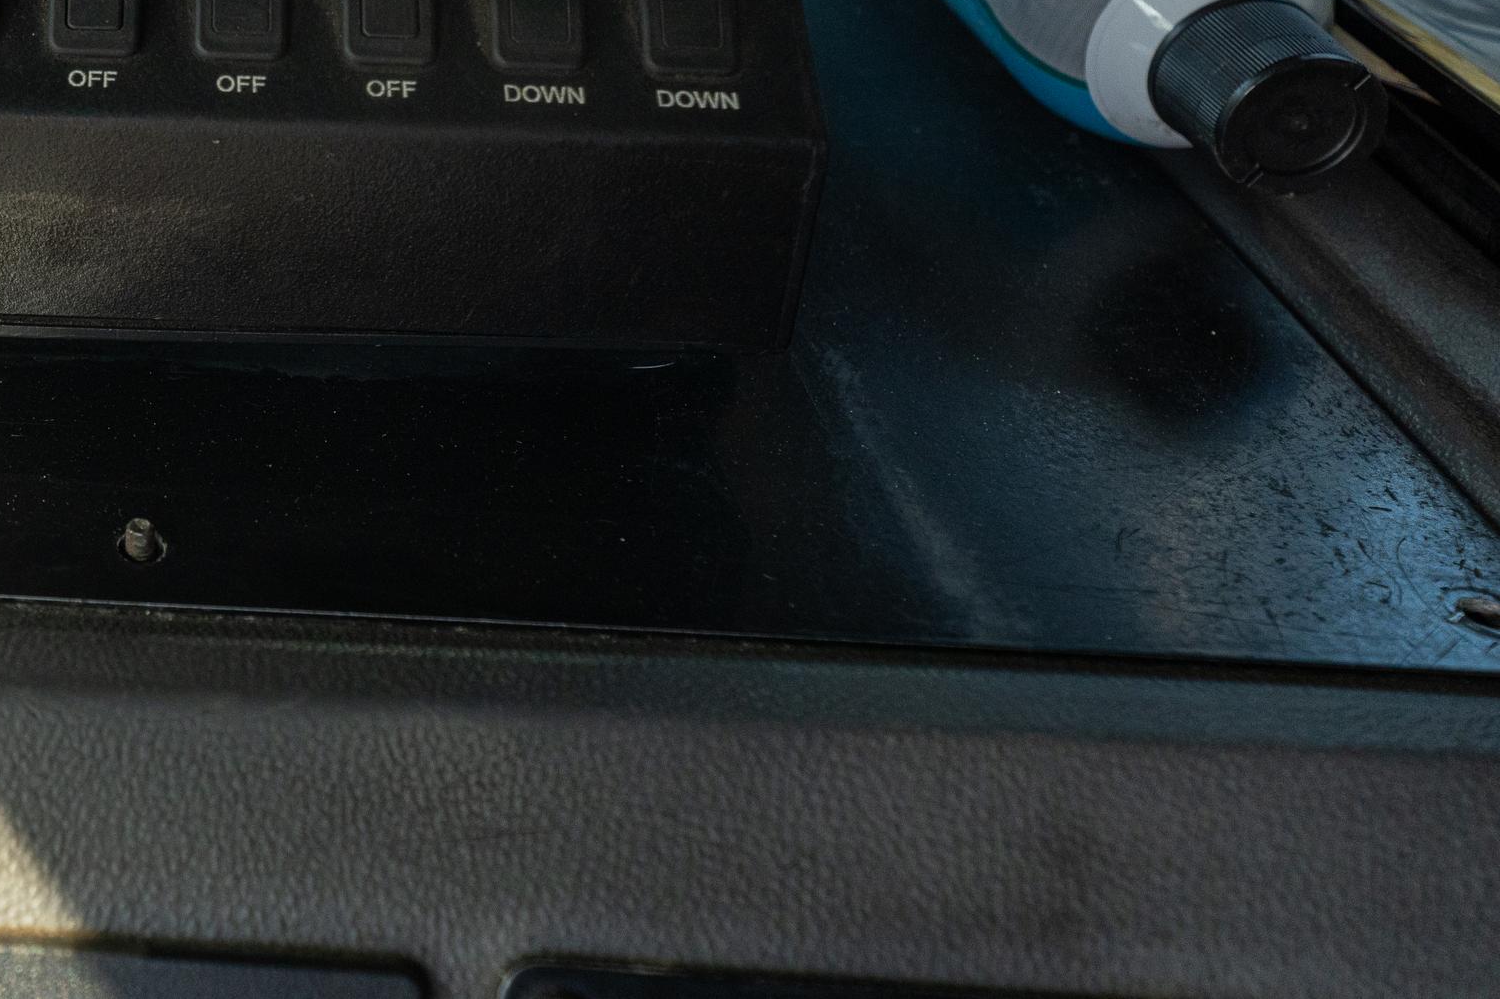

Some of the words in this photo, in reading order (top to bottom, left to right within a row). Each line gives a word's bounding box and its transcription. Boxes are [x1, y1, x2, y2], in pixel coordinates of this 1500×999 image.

[68, 70, 117, 87] OFF
[217, 75, 266, 93] OFF
[366, 80, 416, 98] OFF
[504, 84, 585, 104] DOWN
[657, 90, 739, 109] DOWN
